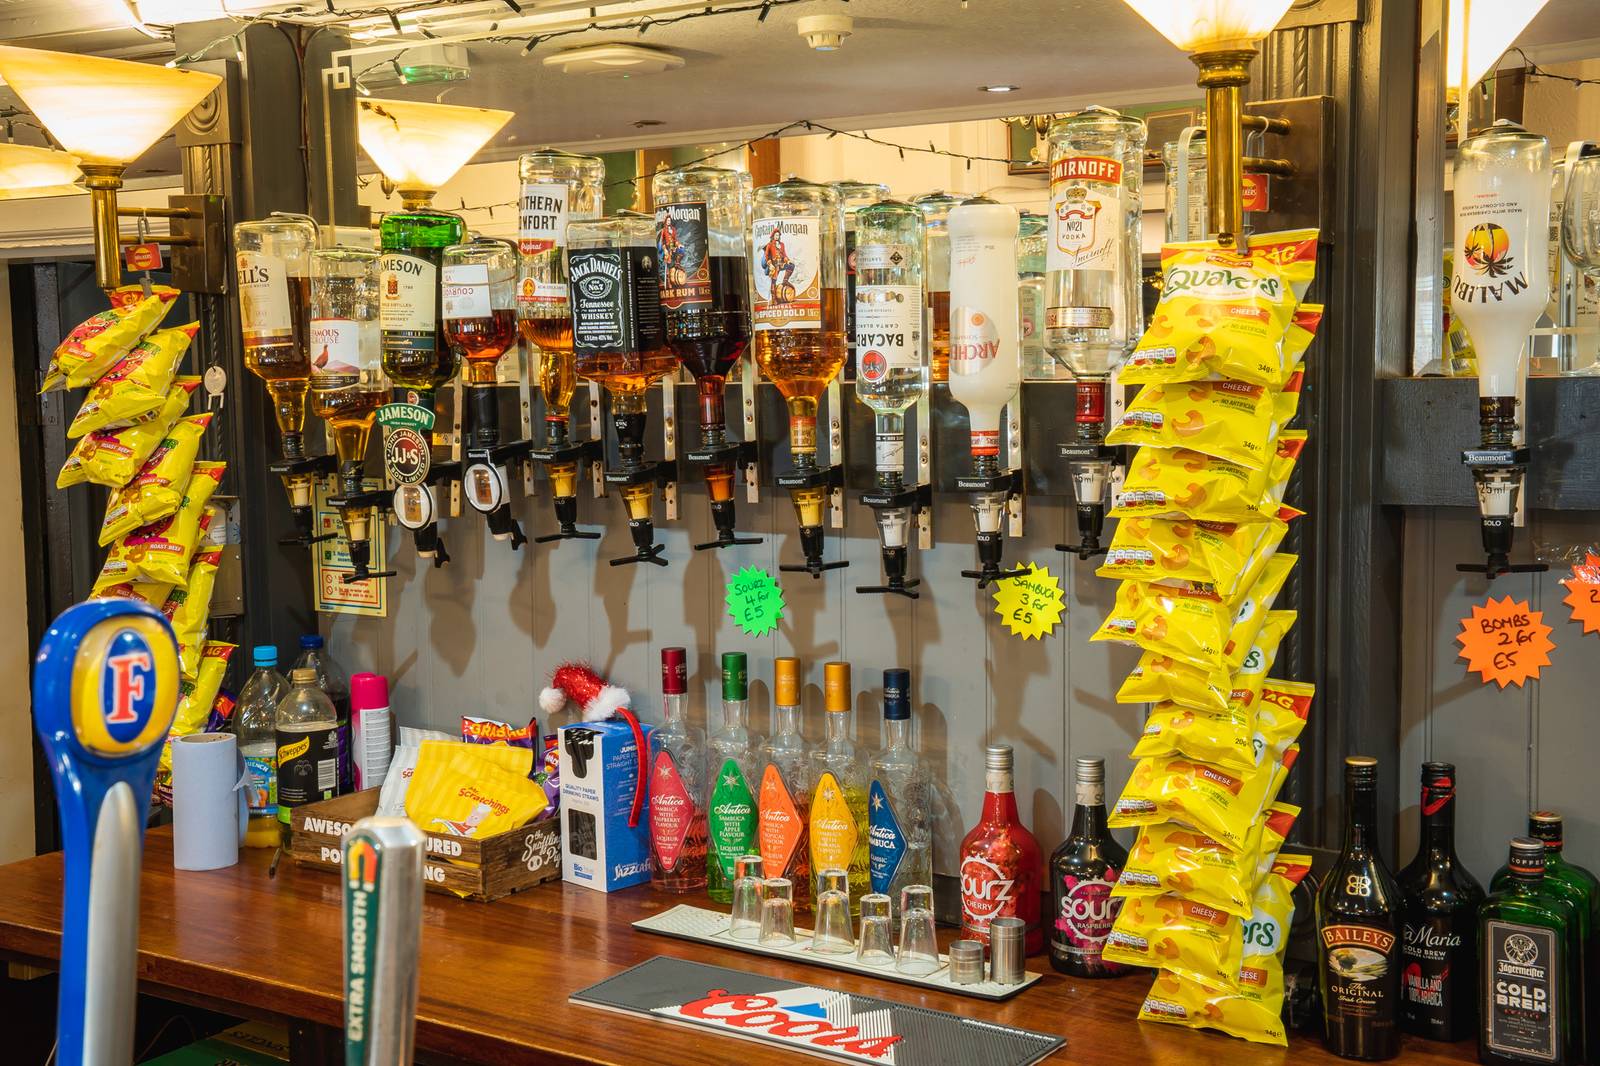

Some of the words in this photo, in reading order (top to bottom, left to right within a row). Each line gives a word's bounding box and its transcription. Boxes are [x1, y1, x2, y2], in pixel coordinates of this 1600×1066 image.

[1051, 160, 1115, 181] SMIRNOFF
[523, 196, 562, 213] THERN
[669, 206, 700, 222] Morgan
[775, 221, 808, 236] Morgan
[239, 264, 269, 286] ELL'S
[570, 261, 589, 282] JACK
[1162, 267, 1280, 300] Quavers
[1454, 271, 1529, 303] MALIBU
[676, 288, 695, 298] RUM
[580, 298, 614, 309] Tennessee
[783, 308, 805, 317] GOLD
[1222, 382, 1252, 392] CHEESE
[378, 405, 430, 426] JAMESON
[1468, 454, 1507, 462] Beaumont
[1013, 577, 1054, 600] SAMBUCA
[745, 595, 756, 606] 4
[1020, 593, 1029, 605] 3
[1032, 599, 1048, 611] for
[1481, 614, 1530, 634] BOMBS
[1498, 632, 1512, 645] 2
[106, 650, 151, 724] F
[1264, 692, 1295, 709] AG
[278, 742, 308, 762] Schweppes
[247, 761, 269, 773] UENCH
[1203, 769, 1232, 786] CHEESE
[458, 787, 511, 815] Scratchings
[651, 793, 684, 806] Antica
[714, 801, 751, 815] Antica
[760, 808, 791, 822] Antica
[304, 817, 351, 837] AWESO
[425, 837, 462, 857] URED
[424, 865, 445, 883] NG
[573, 863, 583, 872] Bio
[966, 899, 993, 911] CHERRY
[1191, 905, 1217, 919] CHEESE
[351, 890, 368, 975] SMOOTH
[1325, 927, 1391, 948] BAILEYS
[1411, 925, 1461, 948] Maria
[1424, 948, 1447, 957] BREW
[1240, 971, 1259, 981] EESE
[1408, 974, 1430, 990] VANILLA
[1430, 978, 1443, 992] AND
[1331, 985, 1384, 998] ORIGINAL
[1348, 982, 1367, 990] The
[1496, 980, 1547, 1001] COLD
[347, 977, 365, 1042] EXTRA
[1496, 993, 1547, 1013] BREW
[680, 988, 903, 1058] Coors
